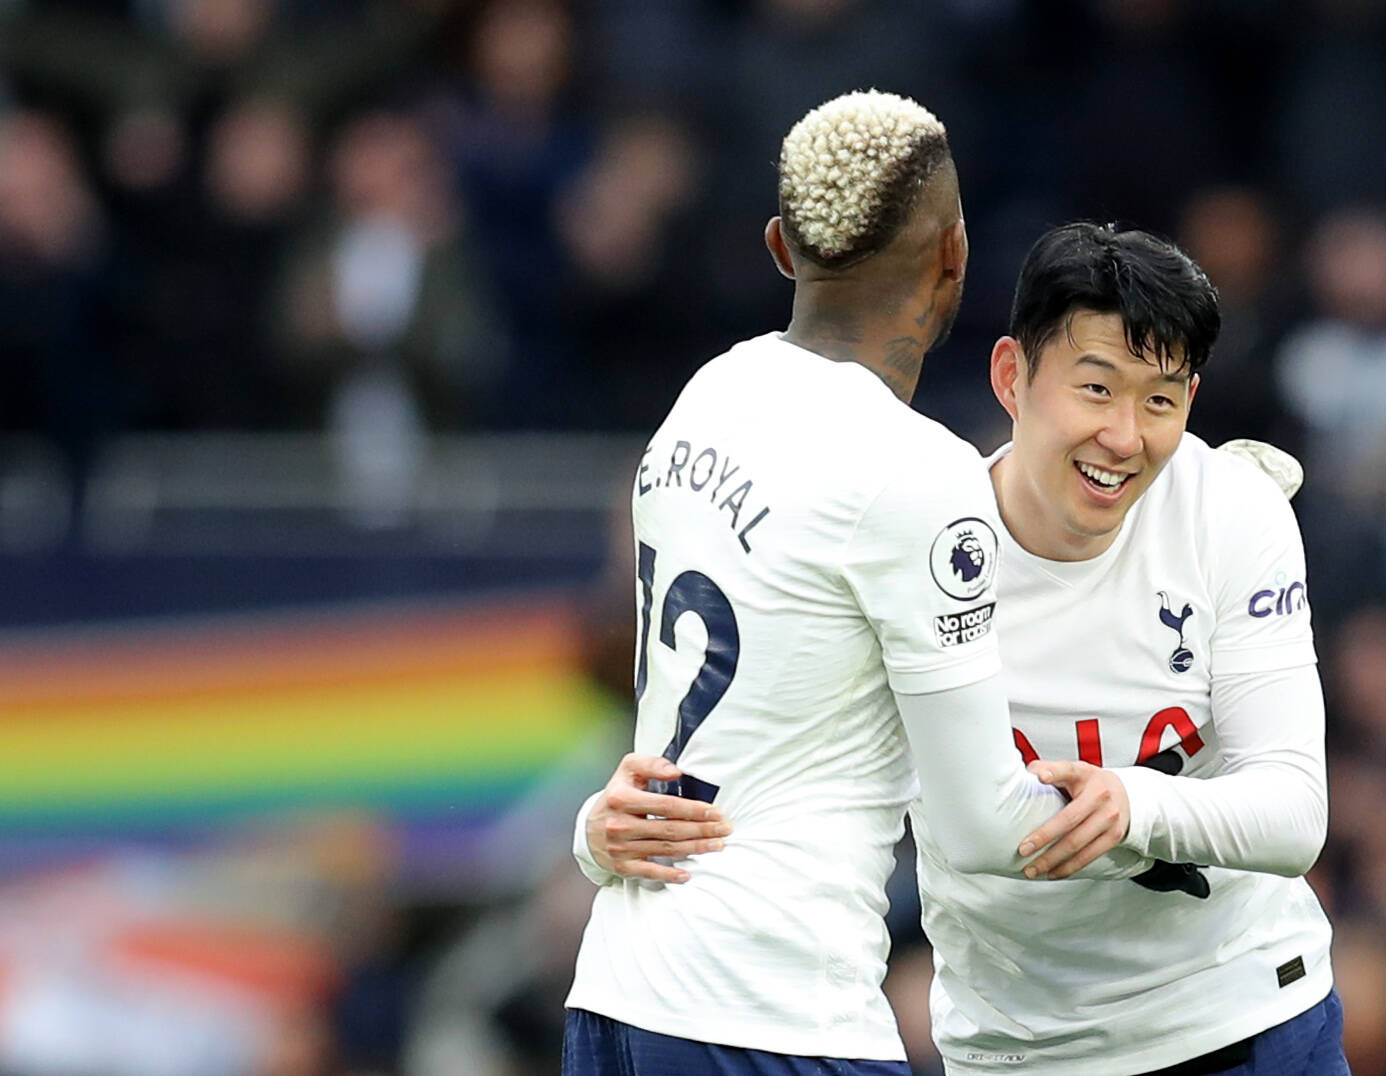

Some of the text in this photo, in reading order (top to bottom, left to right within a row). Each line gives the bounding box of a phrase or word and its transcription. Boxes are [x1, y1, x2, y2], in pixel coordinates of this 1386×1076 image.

[639, 440, 770, 554] E.ROYAL
[934, 606, 991, 633] No room
